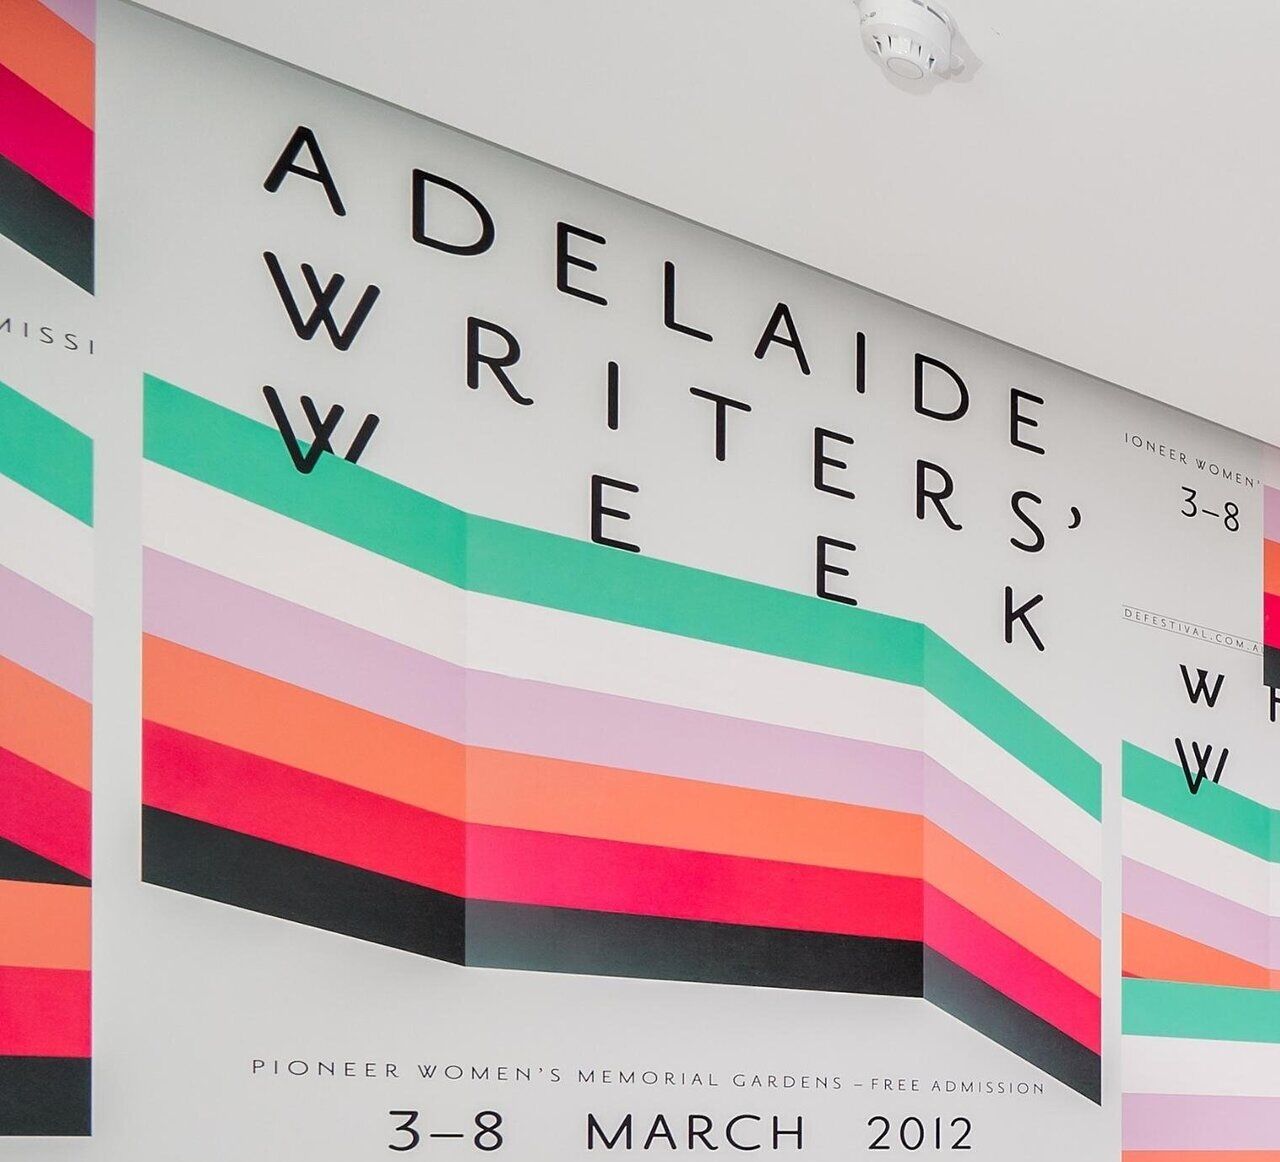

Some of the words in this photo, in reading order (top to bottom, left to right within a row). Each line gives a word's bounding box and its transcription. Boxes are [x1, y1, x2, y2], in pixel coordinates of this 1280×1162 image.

[263, 126, 1045, 455] ADELAIDE
[1125, 431, 1188, 464] IONEER
[253, 1060, 399, 1078] PIONEER
[579, 1070, 718, 1086] MEMORIAL
[733, 1074, 841, 1089] GARDENS
[932, 1081, 1046, 1094] ADMISSION
[588, 1113, 802, 1151] MARCH
[868, 1116, 971, 1150] 2012
